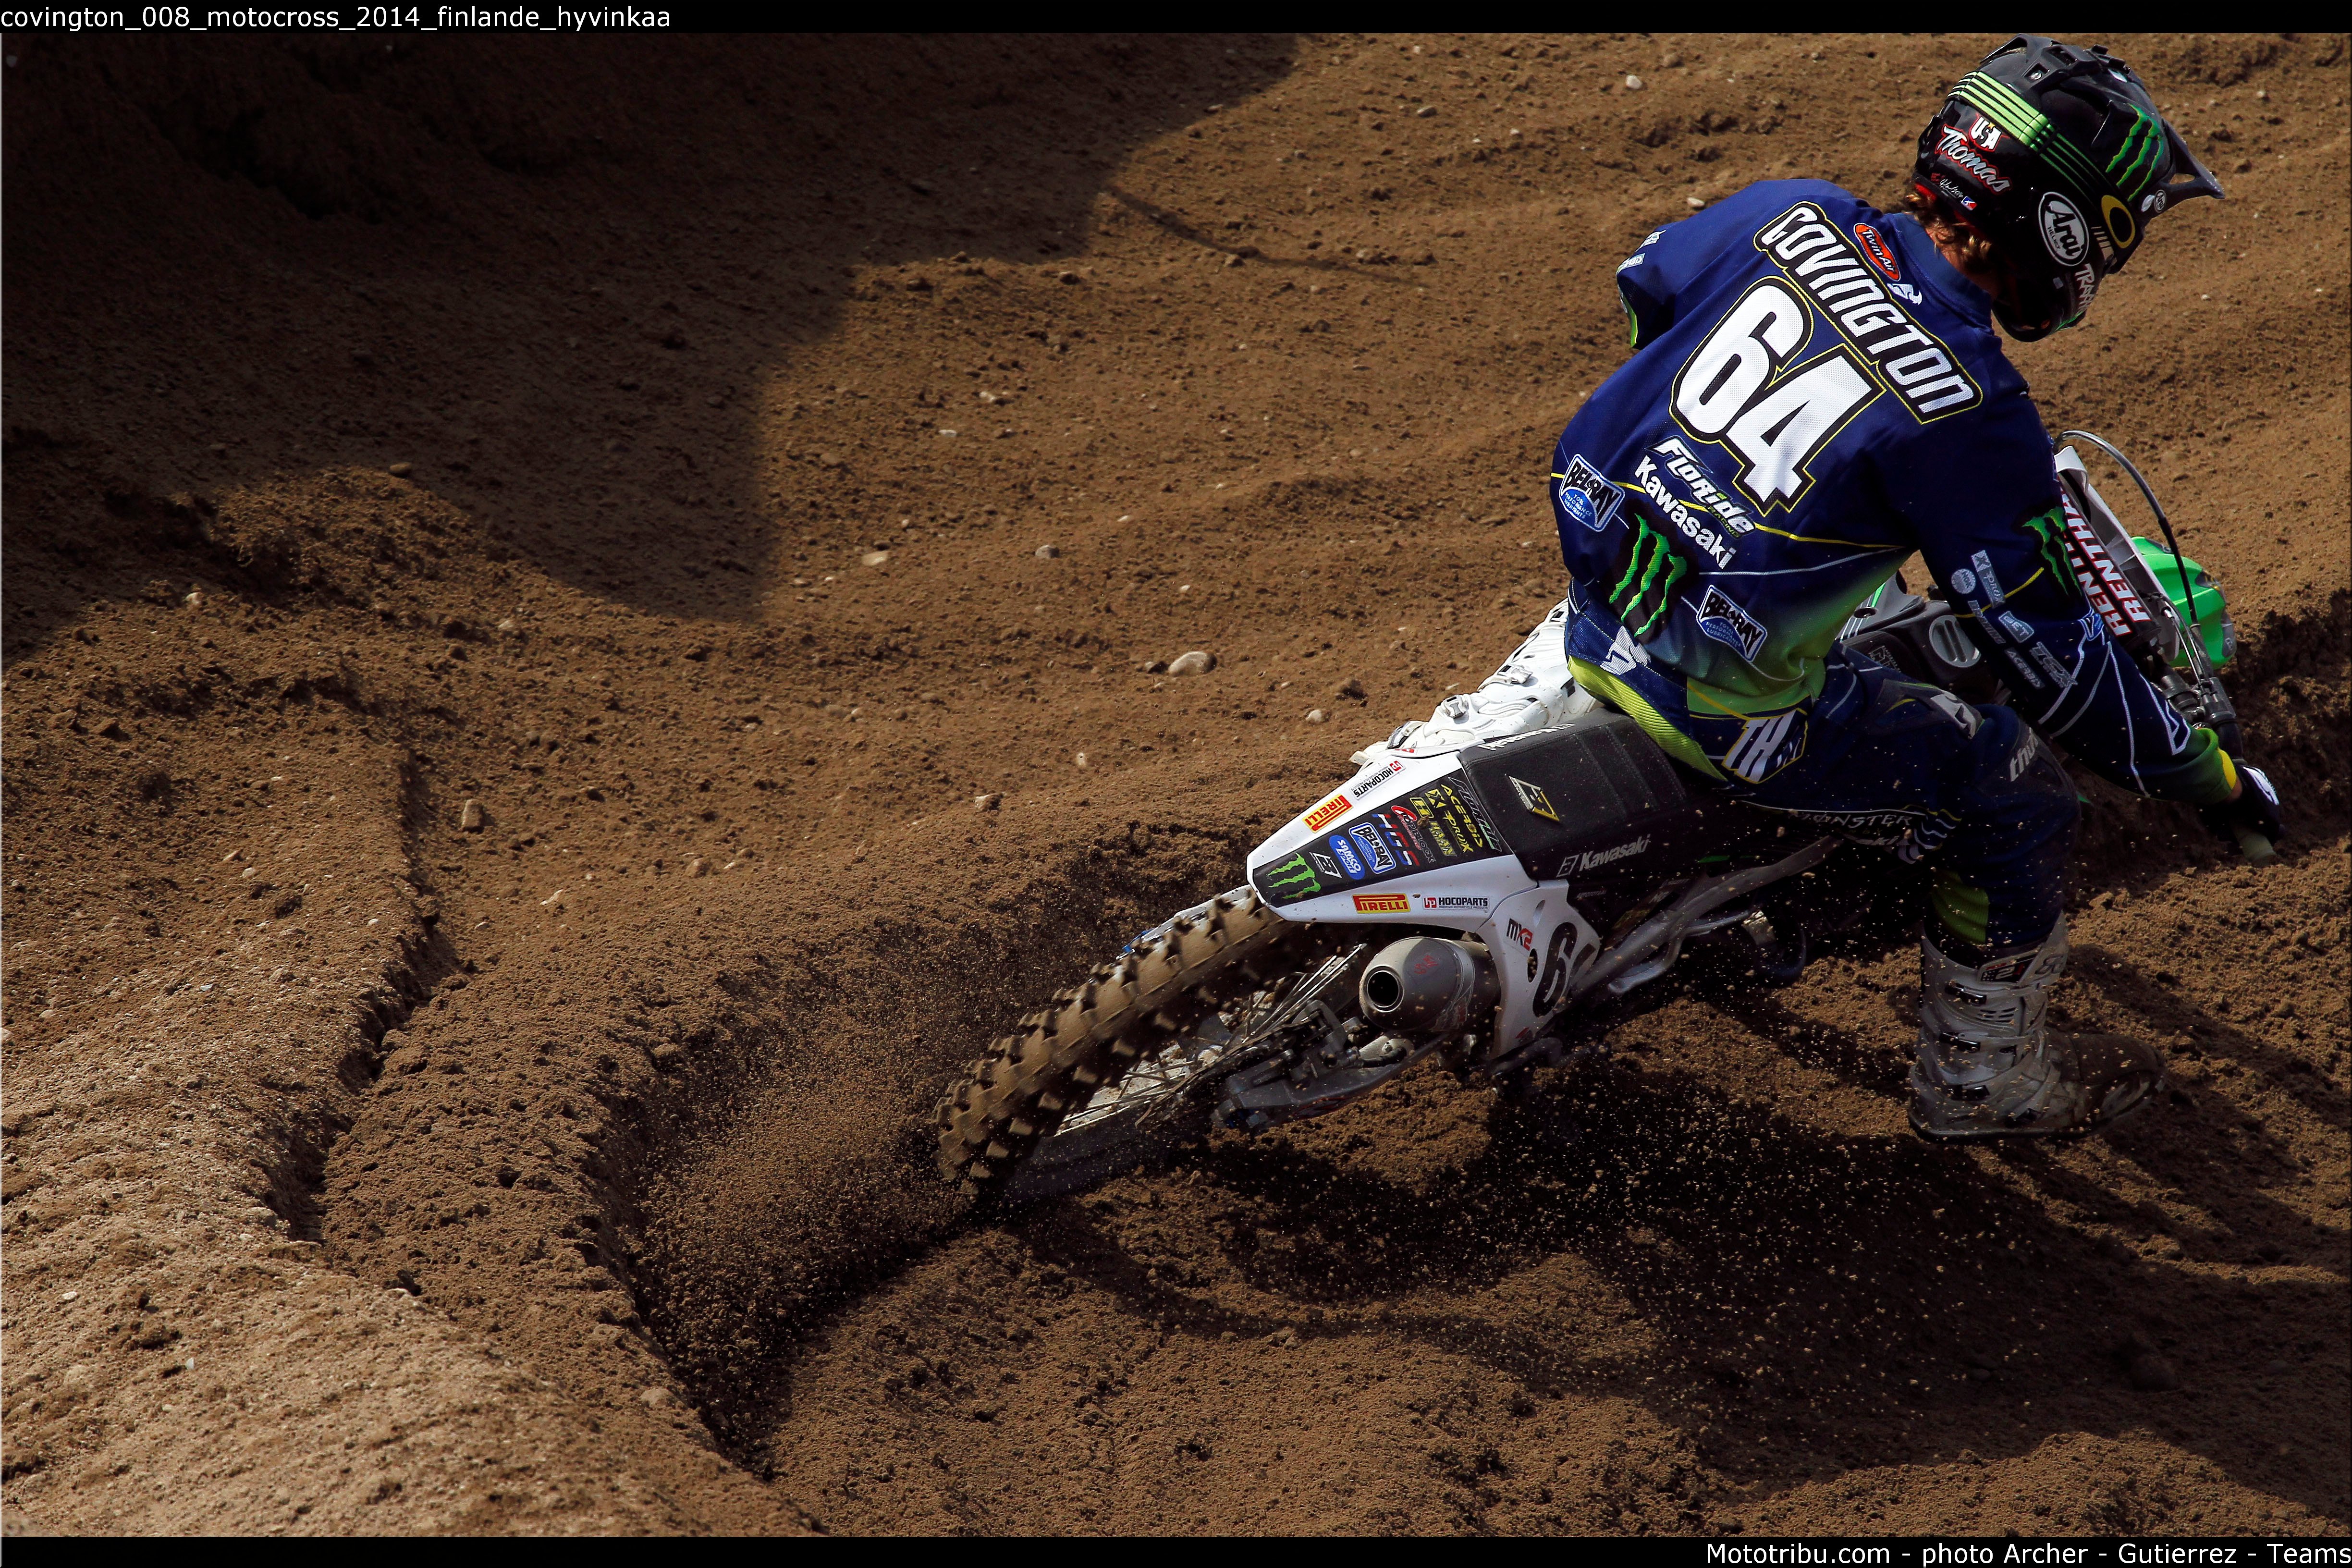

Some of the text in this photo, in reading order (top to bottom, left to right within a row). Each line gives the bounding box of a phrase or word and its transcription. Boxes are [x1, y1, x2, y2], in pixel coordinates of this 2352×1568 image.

[1862, 229, 1895, 272] Twin Air
[2045, 202, 2085, 256] Arai
[1760, 206, 1974, 414] COVINGTON
[1675, 285, 1874, 503] 64
[1634, 455, 1737, 569] Kawasaki
[2060, 487, 2152, 622] RENTHA
[1353, 768, 1394, 797] HOCOPARTS
[1304, 795, 1352, 832] PIRELLI
[1337, 839, 1362, 872] SAMCO
[1371, 813, 1421, 867] HGS
[1579, 833, 1652, 872] Kawasaki
[1352, 894, 1408, 911] PIRELLI
[1439, 897, 1488, 906] HOCOPARTS
